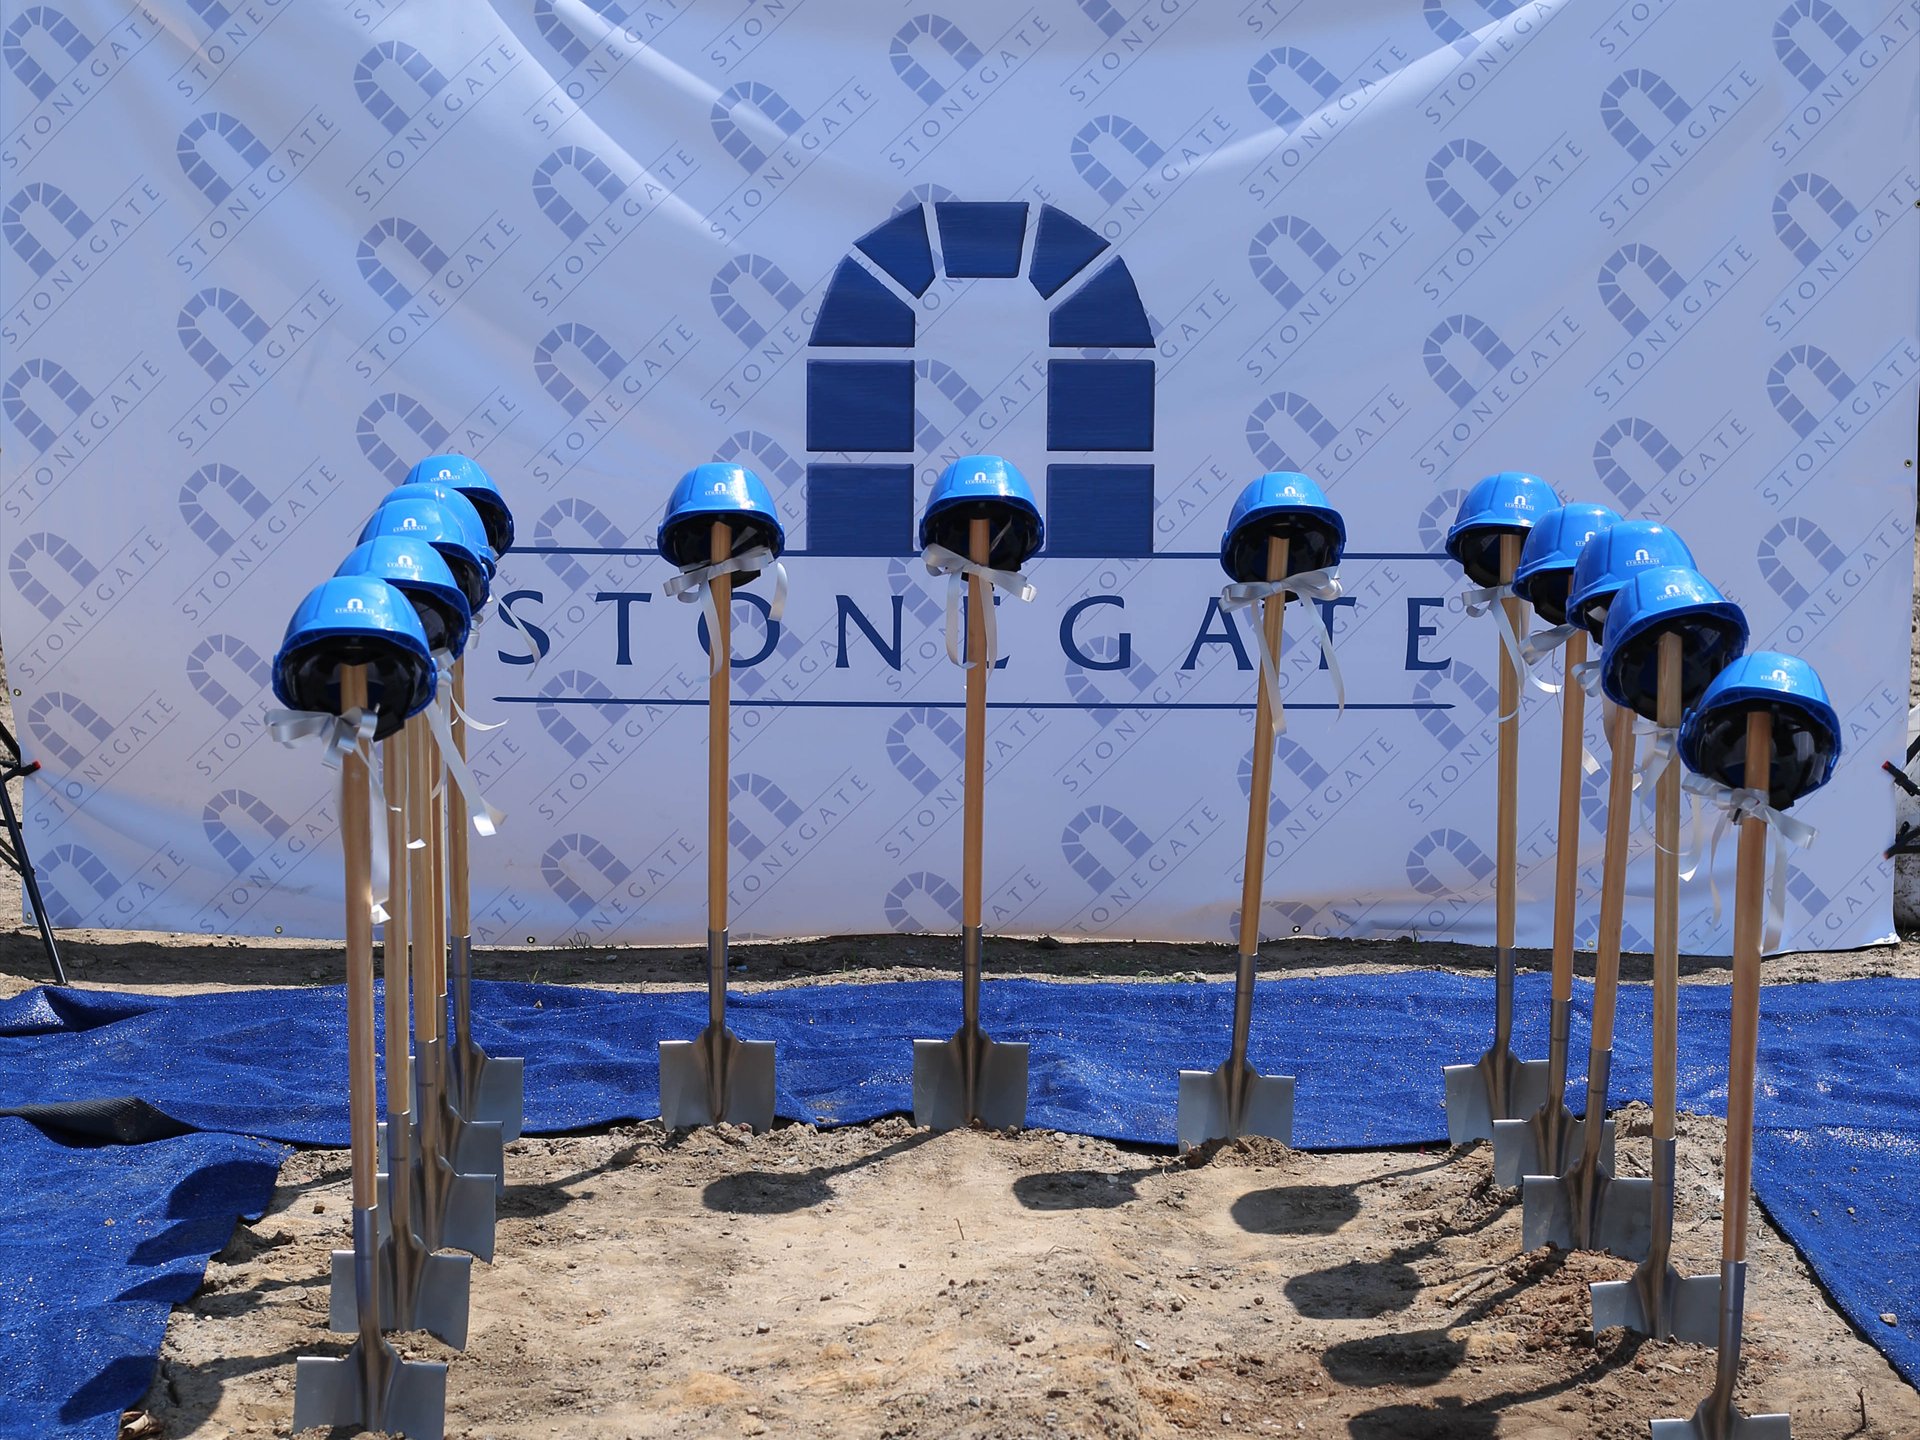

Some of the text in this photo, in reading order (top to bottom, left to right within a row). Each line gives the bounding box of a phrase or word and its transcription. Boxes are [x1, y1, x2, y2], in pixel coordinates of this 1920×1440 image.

[2, 8, 158, 169] STONEGATE
[177, 0, 283, 98] STONE
[355, 43, 516, 203] STONEGATE
[532, 0, 676, 132] STONEGA
[889, 15, 1050, 169] STONEGATE
[1069, 0, 1180, 102] STONEG
[1247, 46, 1407, 203] STONEGATE
[1425, 0, 1552, 125] STONEGA
[177, 113, 334, 273] STONEGATE
[710, 83, 872, 240] STONEGATE
[1103, 115, 1231, 239] ONEGATE
[1423, 140, 1583, 302] STONEGATE
[1599, 70, 1757, 231] STONEGATE
[1, 183, 160, 344] STONEGATE
[355, 217, 515, 379] STONEGATE
[532, 150, 694, 308] STONEGATE
[1247, 217, 1408, 378] STONEGATE
[1765, 174, 1920, 333] STONEGATE
[178, 288, 336, 449] STONEGATE
[1419, 314, 1581, 476] STONEGATE
[1594, 244, 1753, 404] STONEGATE
[3, 359, 160, 518] STONEGATE
[532, 325, 694, 484] STONEGATE
[921, 361, 1048, 487] ONEGATE
[1315, 393, 1405, 480] EGATE
[1641, 418, 1747, 519] NEGATE
[1763, 346, 1920, 505] STONEGATE
[19, 534, 163, 679] STONEGATE
[183, 464, 337, 620] STONEGATE
[1770, 518, 1909, 652] TONEGATE
[35, 692, 174, 830] STONEGATE
[538, 672, 694, 819] STONEGATE
[98, 850, 184, 929] EGATE
[200, 808, 334, 933] STONEGAT
[573, 837, 695, 946] ONEGATE
[728, 775, 868, 905] TONEGATE
[1073, 806, 1219, 932] TONEGATE
